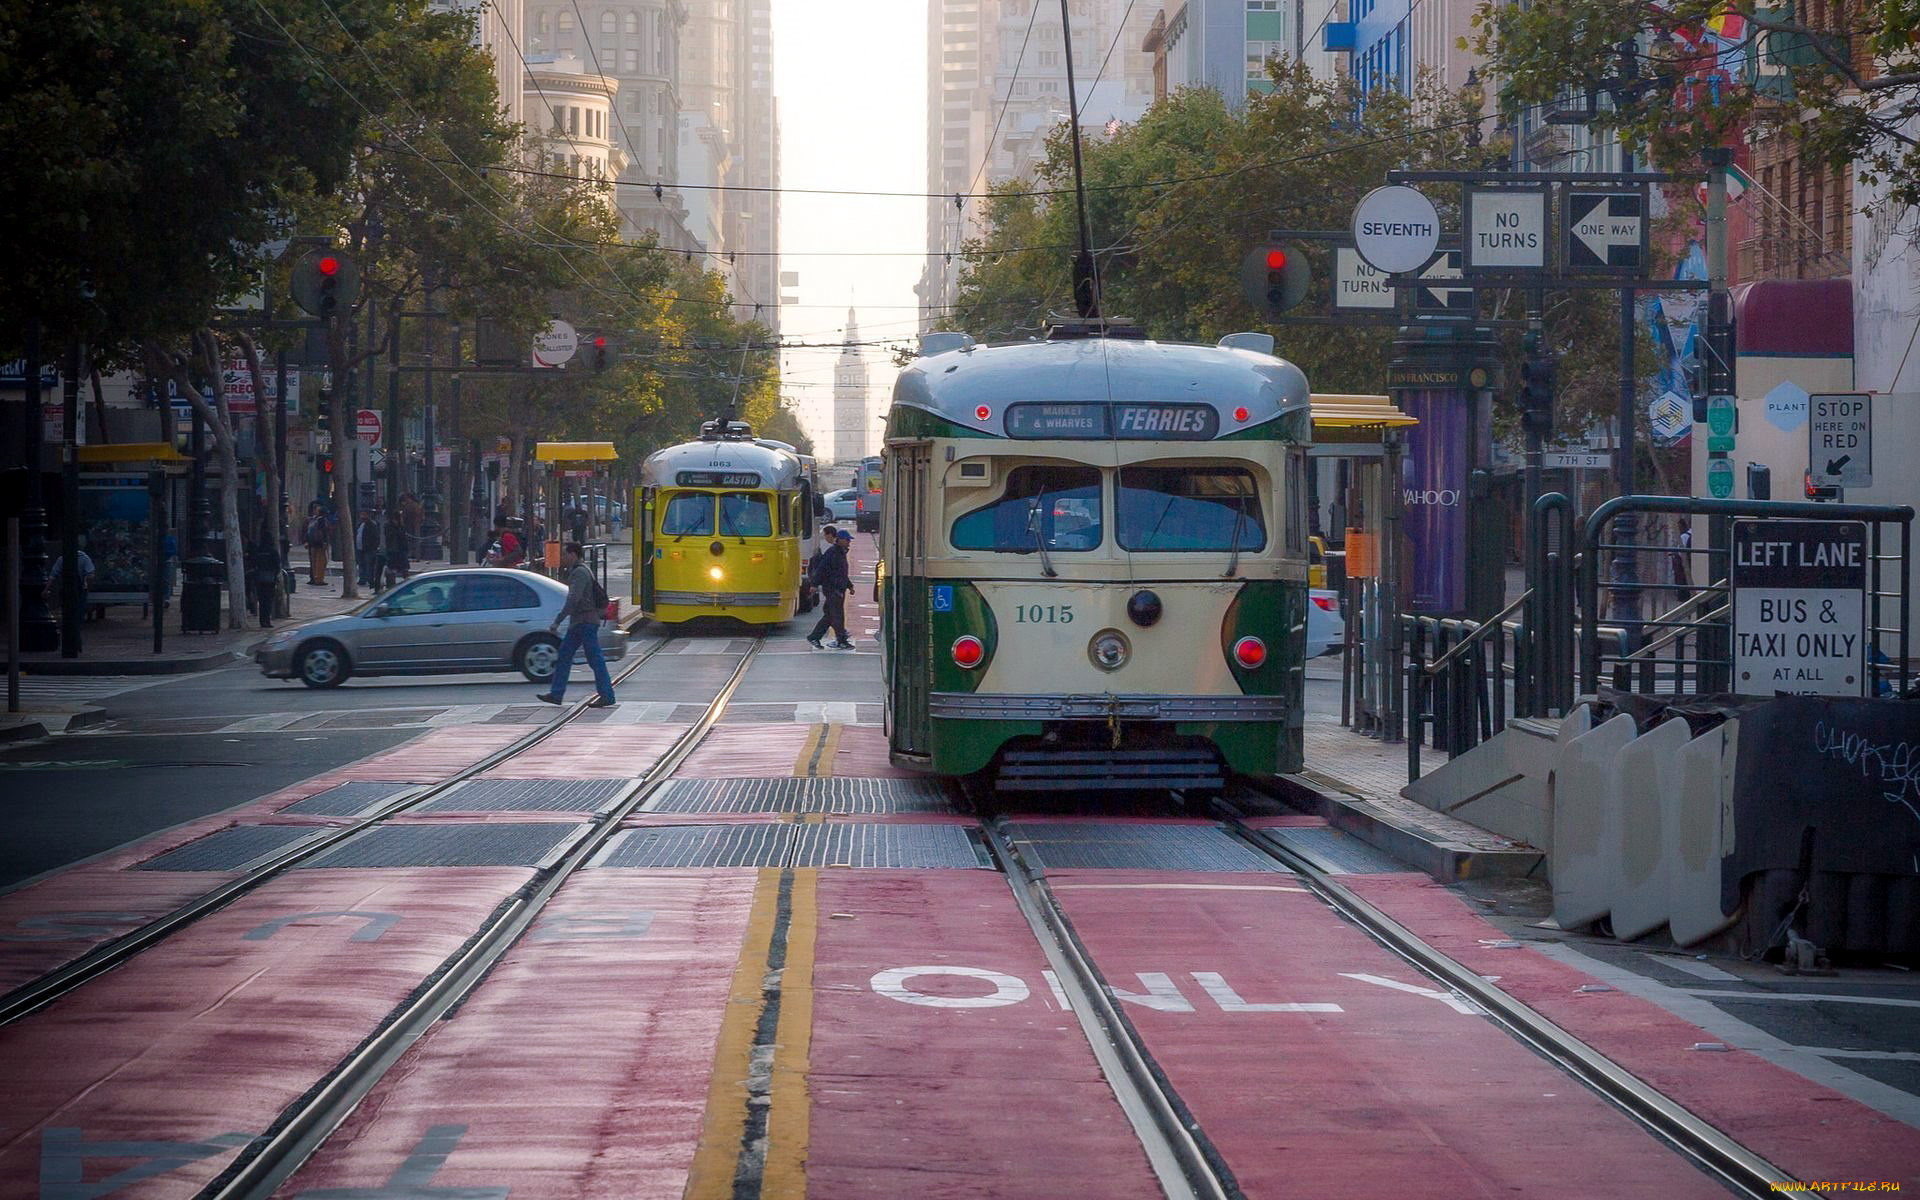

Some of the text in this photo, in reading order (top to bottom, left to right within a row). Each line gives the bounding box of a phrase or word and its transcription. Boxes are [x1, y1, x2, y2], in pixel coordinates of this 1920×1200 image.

[1495, 213, 1519, 228] NO
[1363, 223, 1431, 236] SEVENTH
[1581, 224, 1636, 236] ONE WAY
[1479, 233, 1537, 249] TURNS
[1356, 265, 1375, 276] NO
[1342, 280, 1390, 293] TURNS
[1406, 373, 1458, 383] FRANCISCO
[1768, 403, 1807, 411] PLANT
[1817, 402, 1863, 416] STOP
[1013, 406, 1207, 432] F MARKET FERRIES
[1046, 417, 1093, 428] WHARVES
[1815, 422, 1866, 431] HERE ON
[1824, 434, 1858, 448] RED
[1558, 456, 1598, 465] 7TH ST
[1402, 488, 1460, 507] YAHOO!
[1715, 486, 1729, 496] 20
[1737, 542, 1861, 567] LEFT LANE
[1015, 604, 1074, 624] 1015
[1760, 599, 1838, 623] BUS &
[1738, 633, 1857, 658] TAXI ONLY
[1773, 668, 1824, 681] AT ALL
